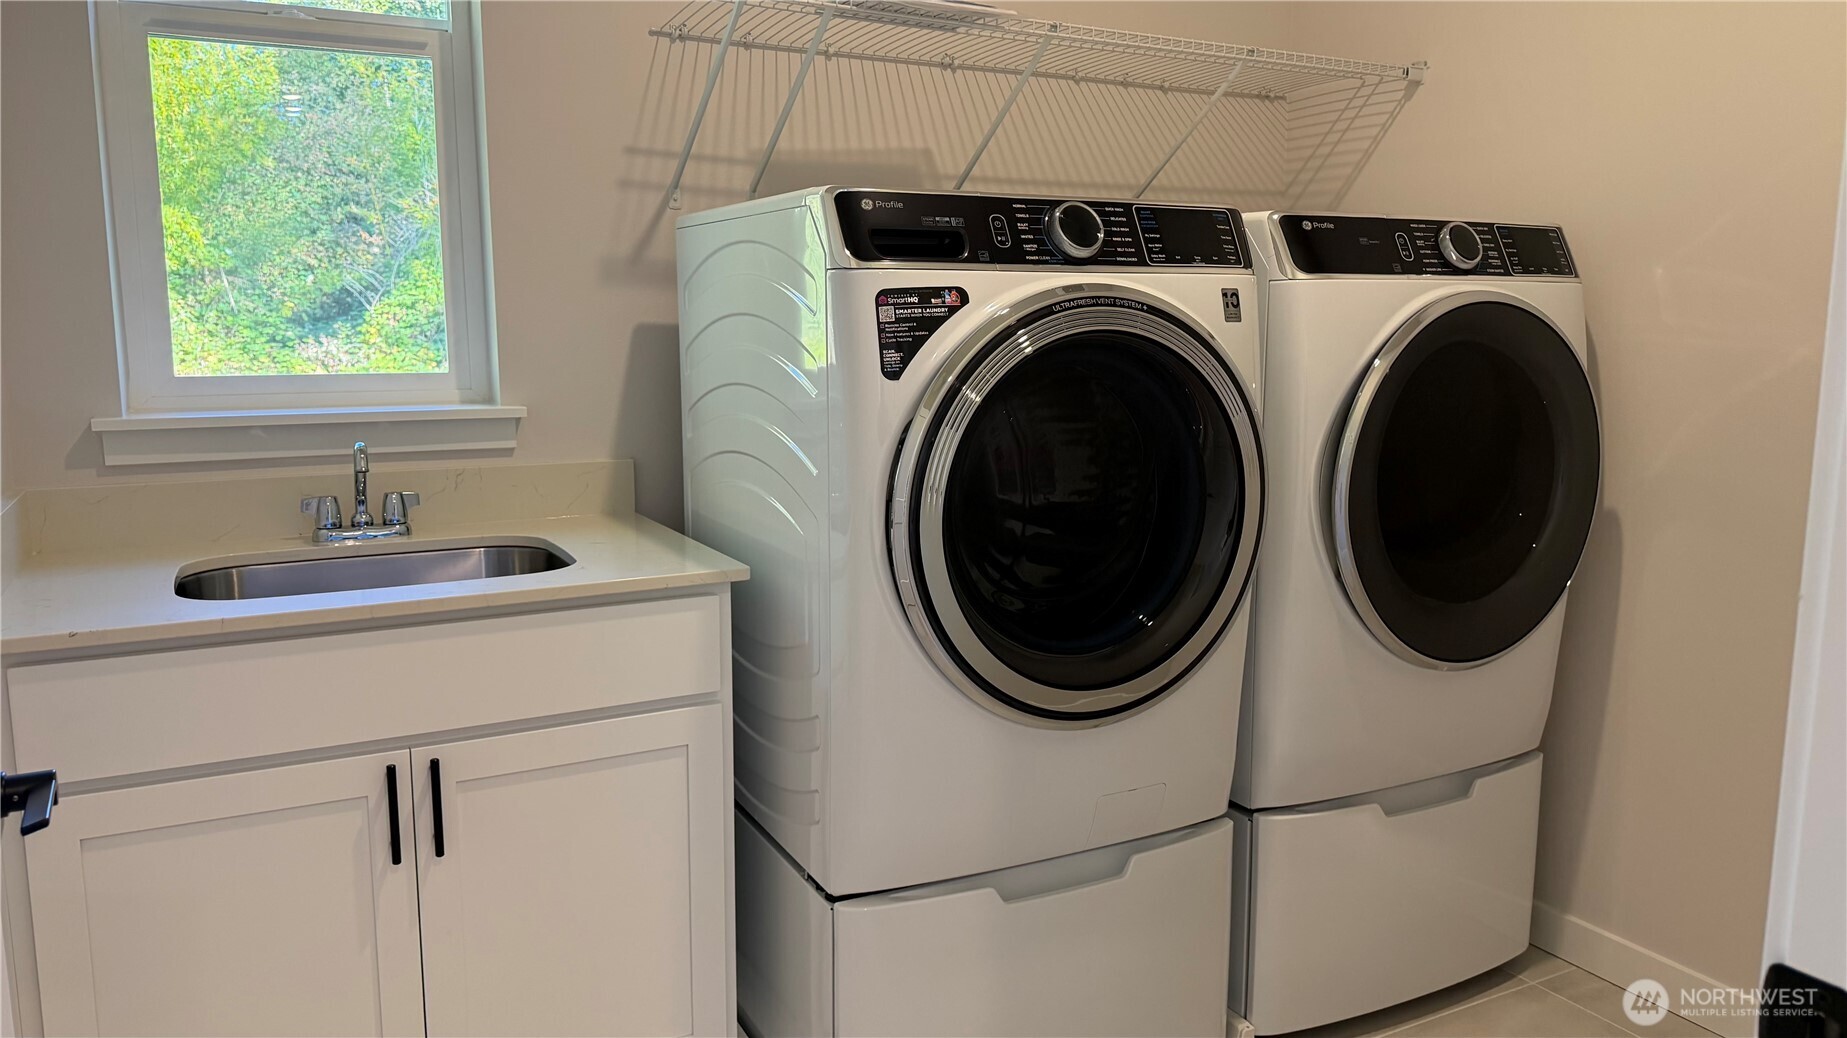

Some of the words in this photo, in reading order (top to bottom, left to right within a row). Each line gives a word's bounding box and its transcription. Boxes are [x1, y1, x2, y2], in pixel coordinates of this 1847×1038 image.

[875, 200, 904, 209] Profile
[1312, 221, 1335, 229] Profile
[887, 296, 919, 304] SmartHQ
[1052, 298, 1096, 312] ULTRAFRESH
[1115, 299, 1142, 310] SYSTEM
